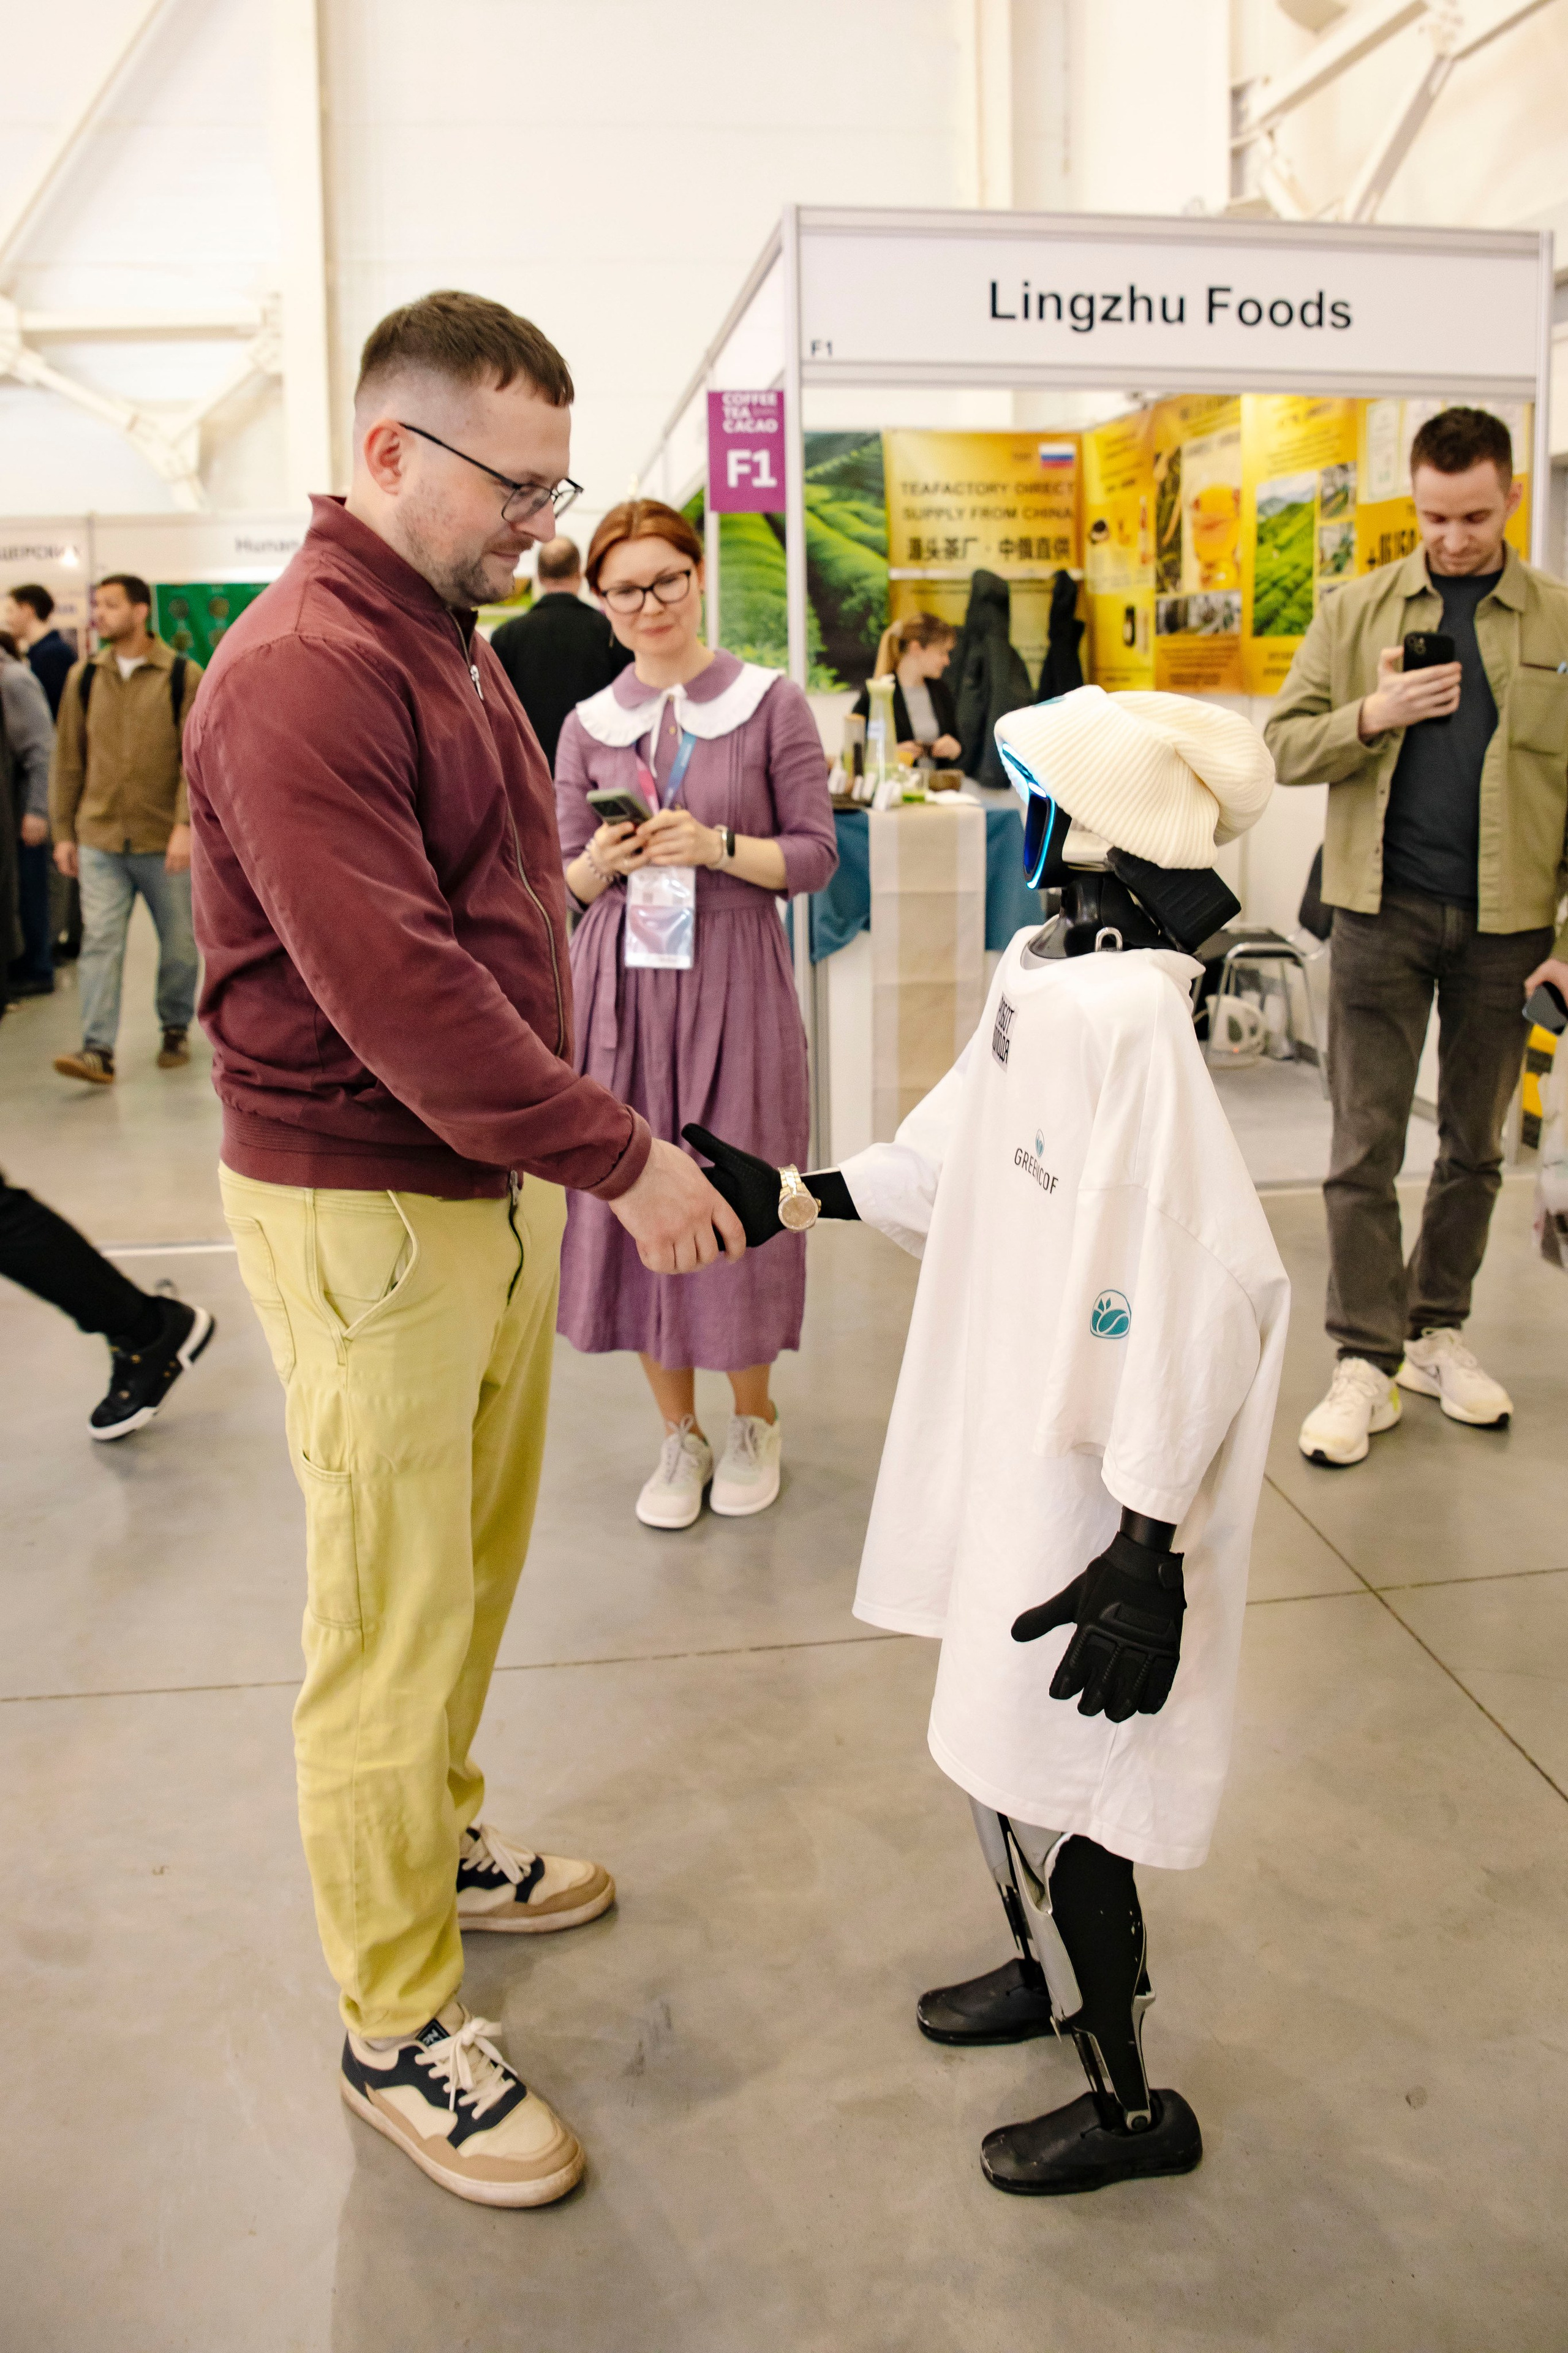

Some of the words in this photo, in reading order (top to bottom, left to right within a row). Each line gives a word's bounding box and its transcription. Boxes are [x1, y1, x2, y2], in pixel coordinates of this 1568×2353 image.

[989, 281, 1185, 333] Lingzhu
[1206, 285, 1353, 330] Foods
[810, 339, 833, 357] F1
[723, 406, 752, 420] TEA
[723, 418, 779, 434] CACAO
[726, 448, 777, 488] F1
[902, 480, 1008, 496] TEAFACTORY
[1013, 480, 1074, 496] DIRECT
[902, 506, 965, 521] SUPPLY
[970, 505, 1018, 519] FROM
[1022, 506, 1074, 519] CHINA
[1014, 1147, 1059, 1195] GREENCOF
